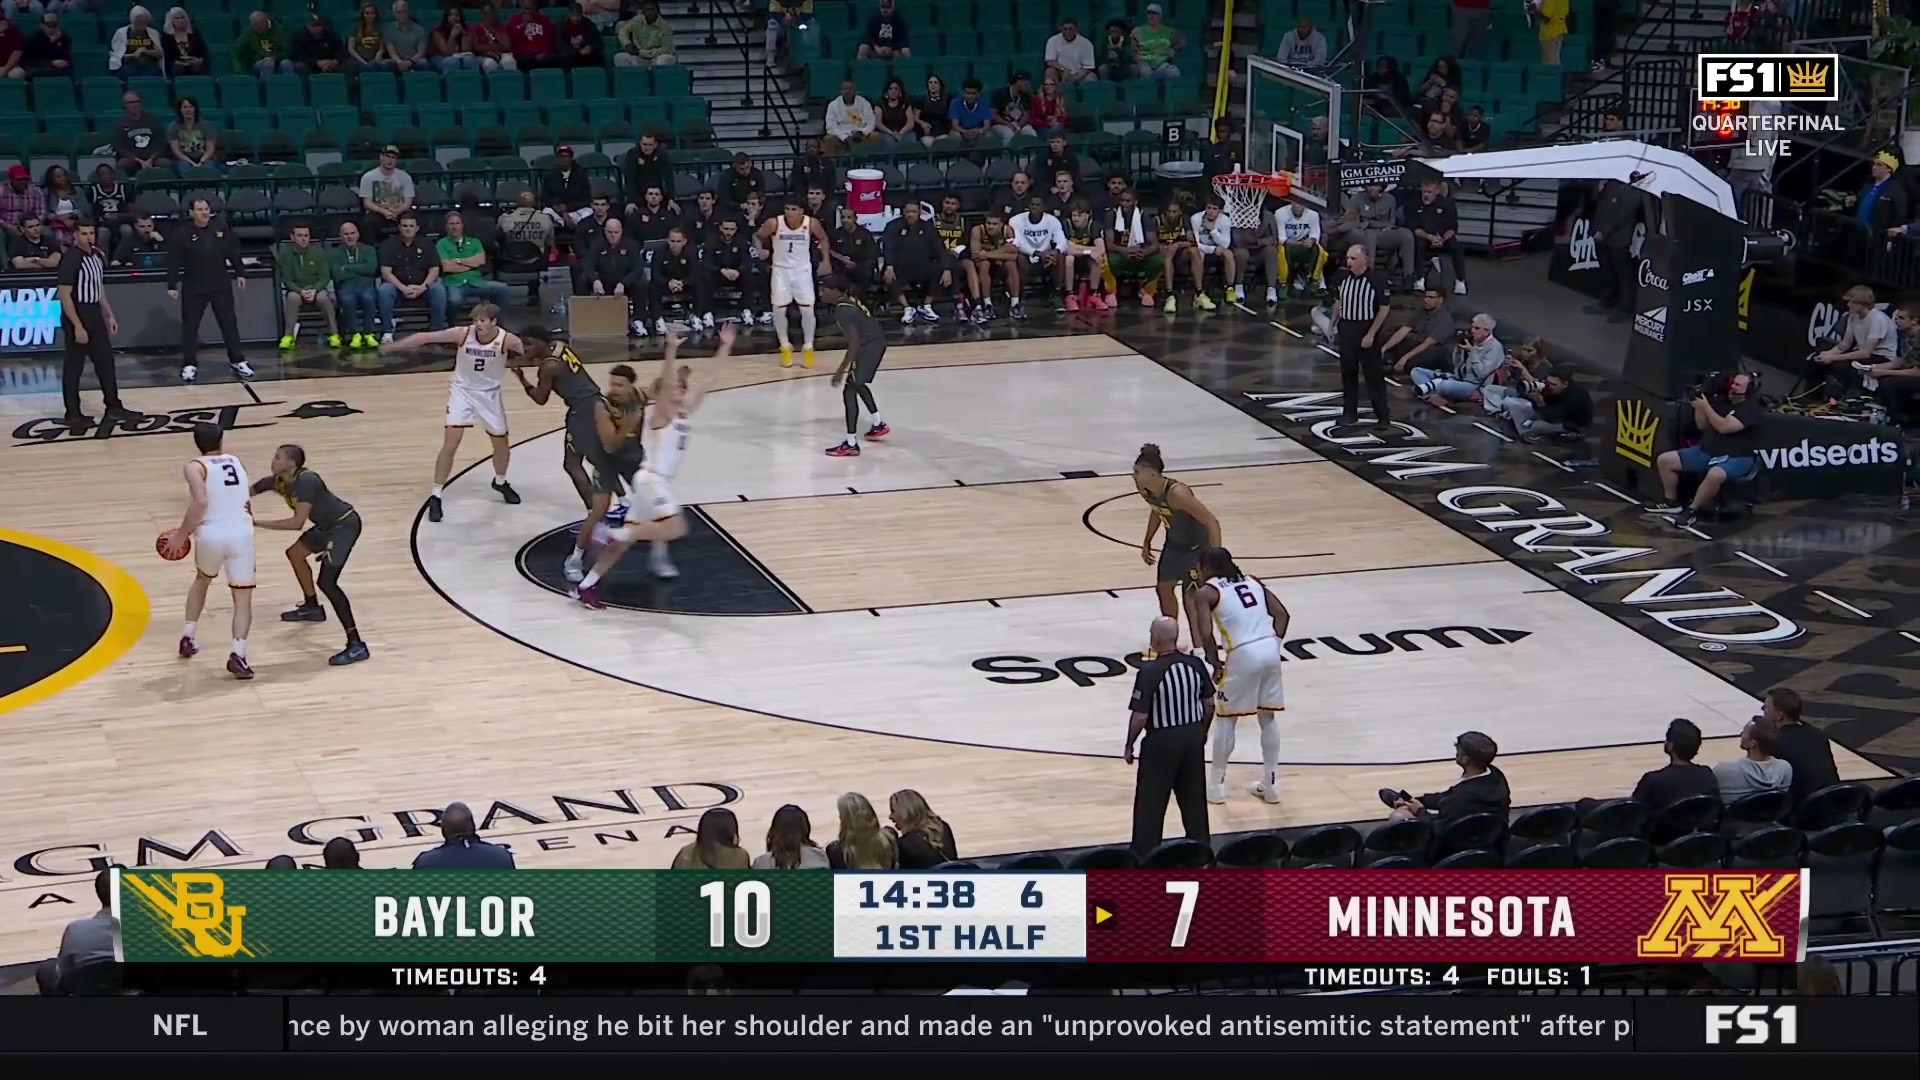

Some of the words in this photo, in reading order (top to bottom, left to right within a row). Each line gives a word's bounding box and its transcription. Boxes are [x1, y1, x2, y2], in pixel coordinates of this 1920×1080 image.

[1169, 128, 1180, 142] B
[1365, 165, 1406, 176] GRAND
[510, 230, 545, 240] POLICE
[1638, 259, 1669, 290] Circa
[1683, 299, 1713, 313] JSX
[474, 359, 485, 371] 2
[1758, 437, 1898, 469] vidseats
[222, 464, 240, 486] 3
[1243, 391, 1491, 481] MGM
[1436, 486, 1807, 645] GRAND
[1234, 585, 1258, 609] 6
[972, 625, 1503, 688] Sprum
[0, 828, 254, 883] GM
[287, 782, 745, 845] GRAND
